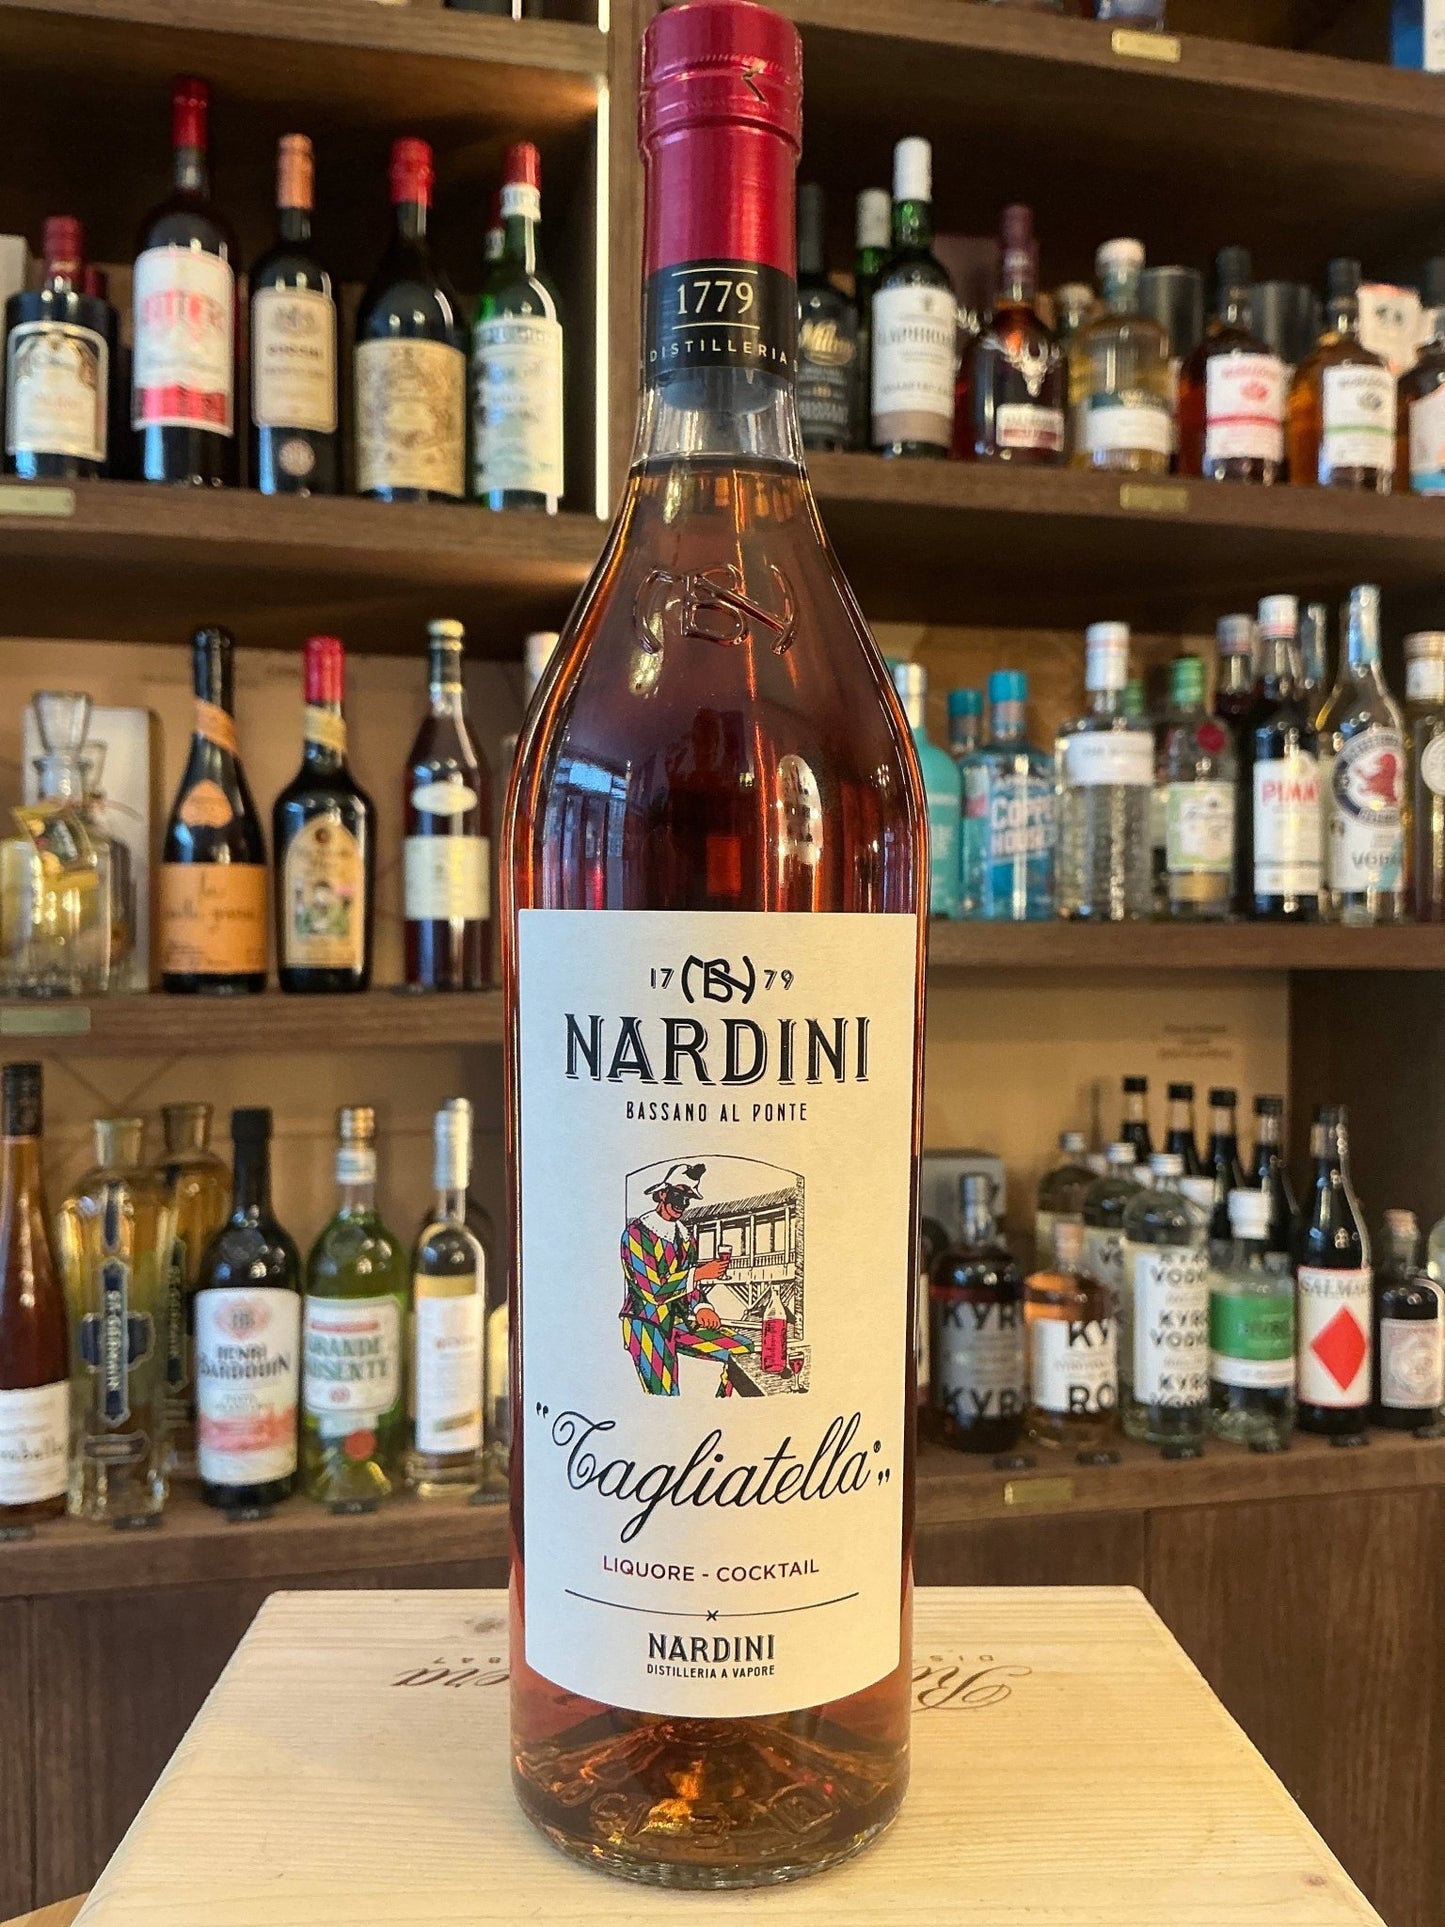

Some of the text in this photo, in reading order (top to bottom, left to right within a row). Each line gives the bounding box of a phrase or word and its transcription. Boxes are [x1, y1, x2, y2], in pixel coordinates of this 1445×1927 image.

[676, 278, 755, 316] 1779
[649, 338, 788, 365] DISTILLERIA
[650, 967, 675, 990] 17
[764, 968, 795, 990] 79
[564, 1013, 871, 1086] NARDINI
[626, 1100, 808, 1122] BASSANO AL PONTE
[603, 1554, 695, 1582] LIQUORE
[716, 1557, 820, 1582] COCKTAIL
[648, 1631, 775, 1663] NARDINI
[646, 1663, 776, 1679] DISTILLERIA A VAPORE
